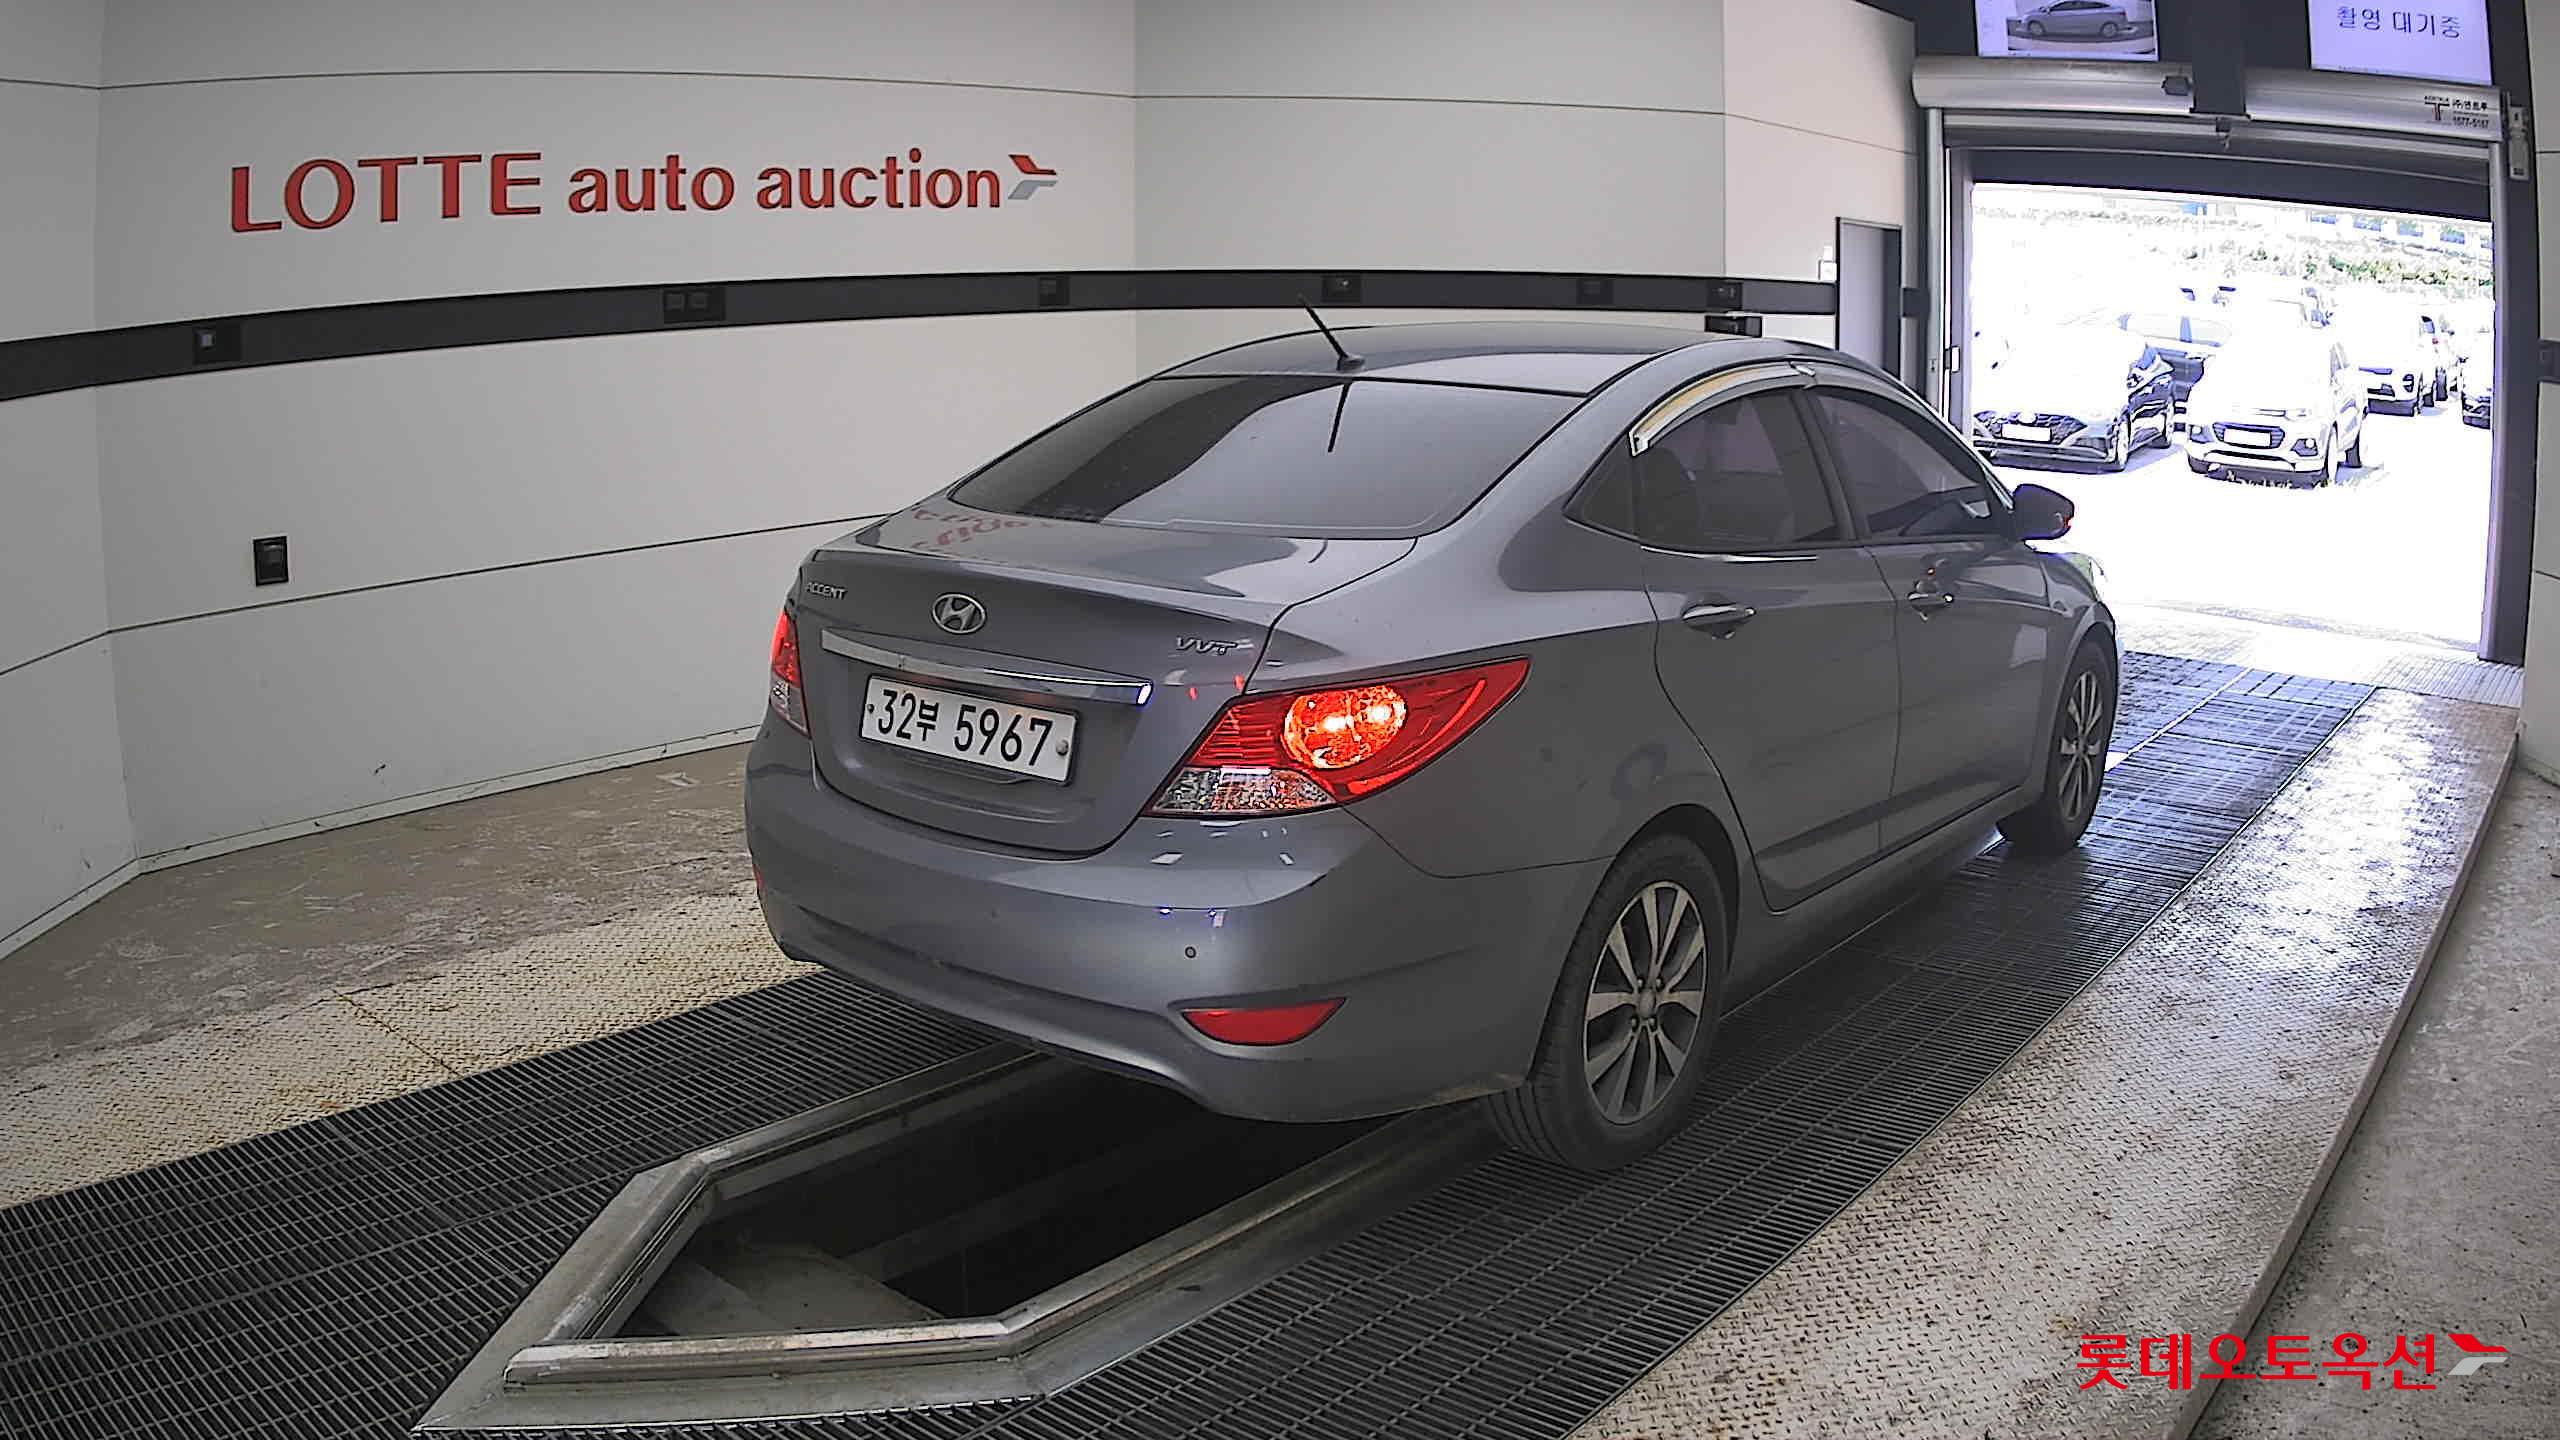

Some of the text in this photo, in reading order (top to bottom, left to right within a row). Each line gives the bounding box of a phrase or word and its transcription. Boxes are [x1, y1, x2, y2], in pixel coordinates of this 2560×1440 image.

[2337, 6, 2461, 39] 촬영 대기중
[231, 147, 1001, 233] LOTTE auto auction
[804, 581, 848, 600] ACCENT
[877, 688, 1054, 767] 32부 5967
